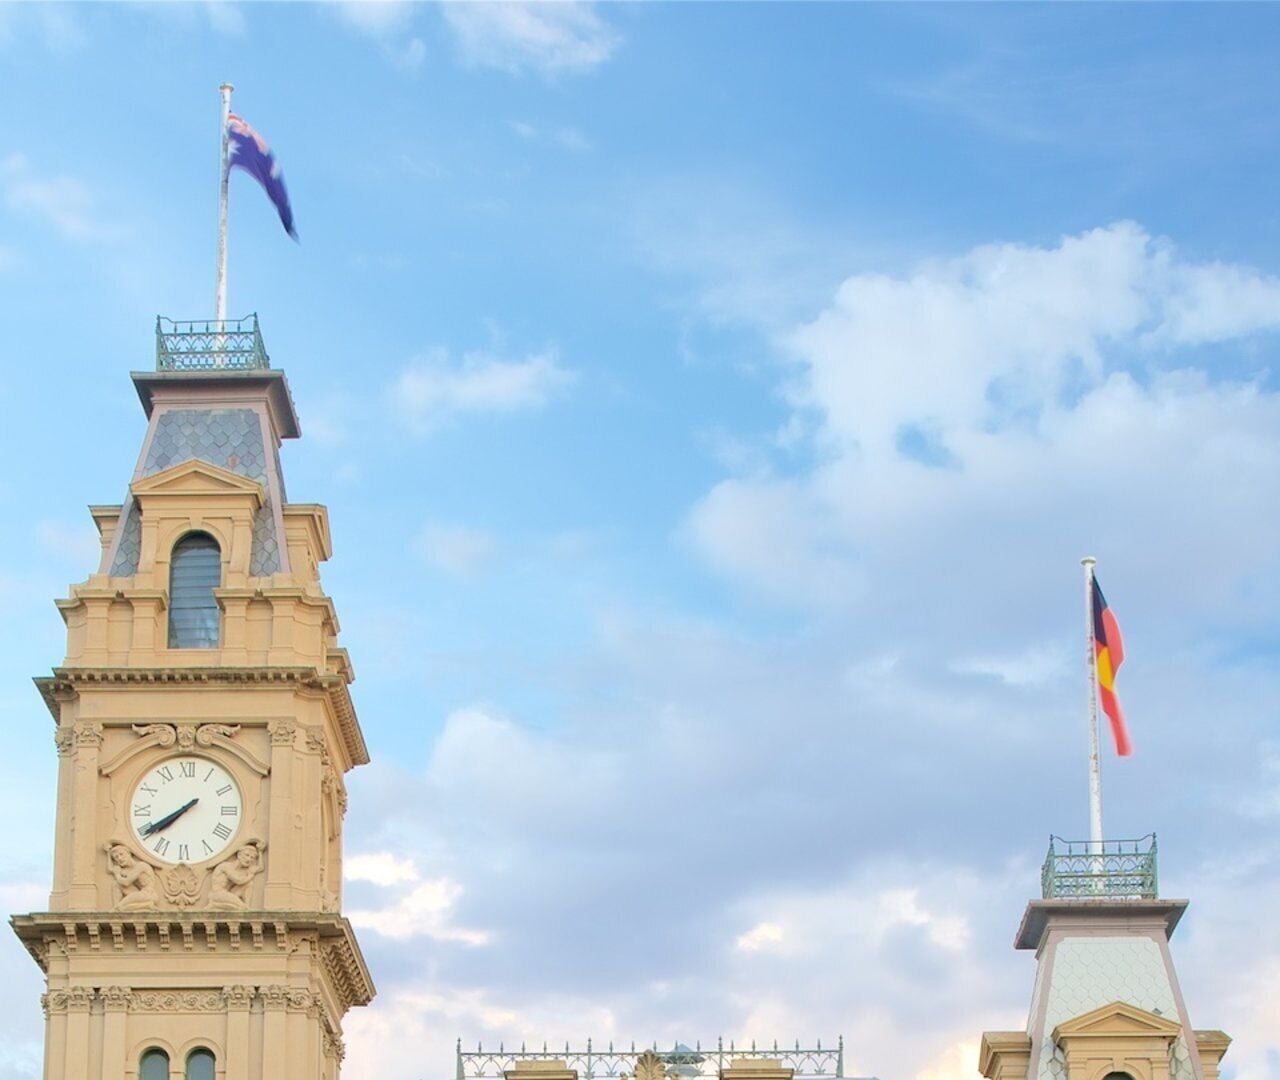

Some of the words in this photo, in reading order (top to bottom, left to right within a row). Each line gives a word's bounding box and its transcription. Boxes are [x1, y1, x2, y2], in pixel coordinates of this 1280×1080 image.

[156, 766, 174, 784] XI
[179, 761, 196, 778] XII
[203, 767, 215, 782] I
[140, 782, 158, 797] X
[216, 784, 233, 796] II
[134, 804, 151, 817] IX
[220, 805, 238, 816] III
[153, 836, 171, 856] VII
[178, 843, 190, 860] VI
[201, 839, 214, 856] V
